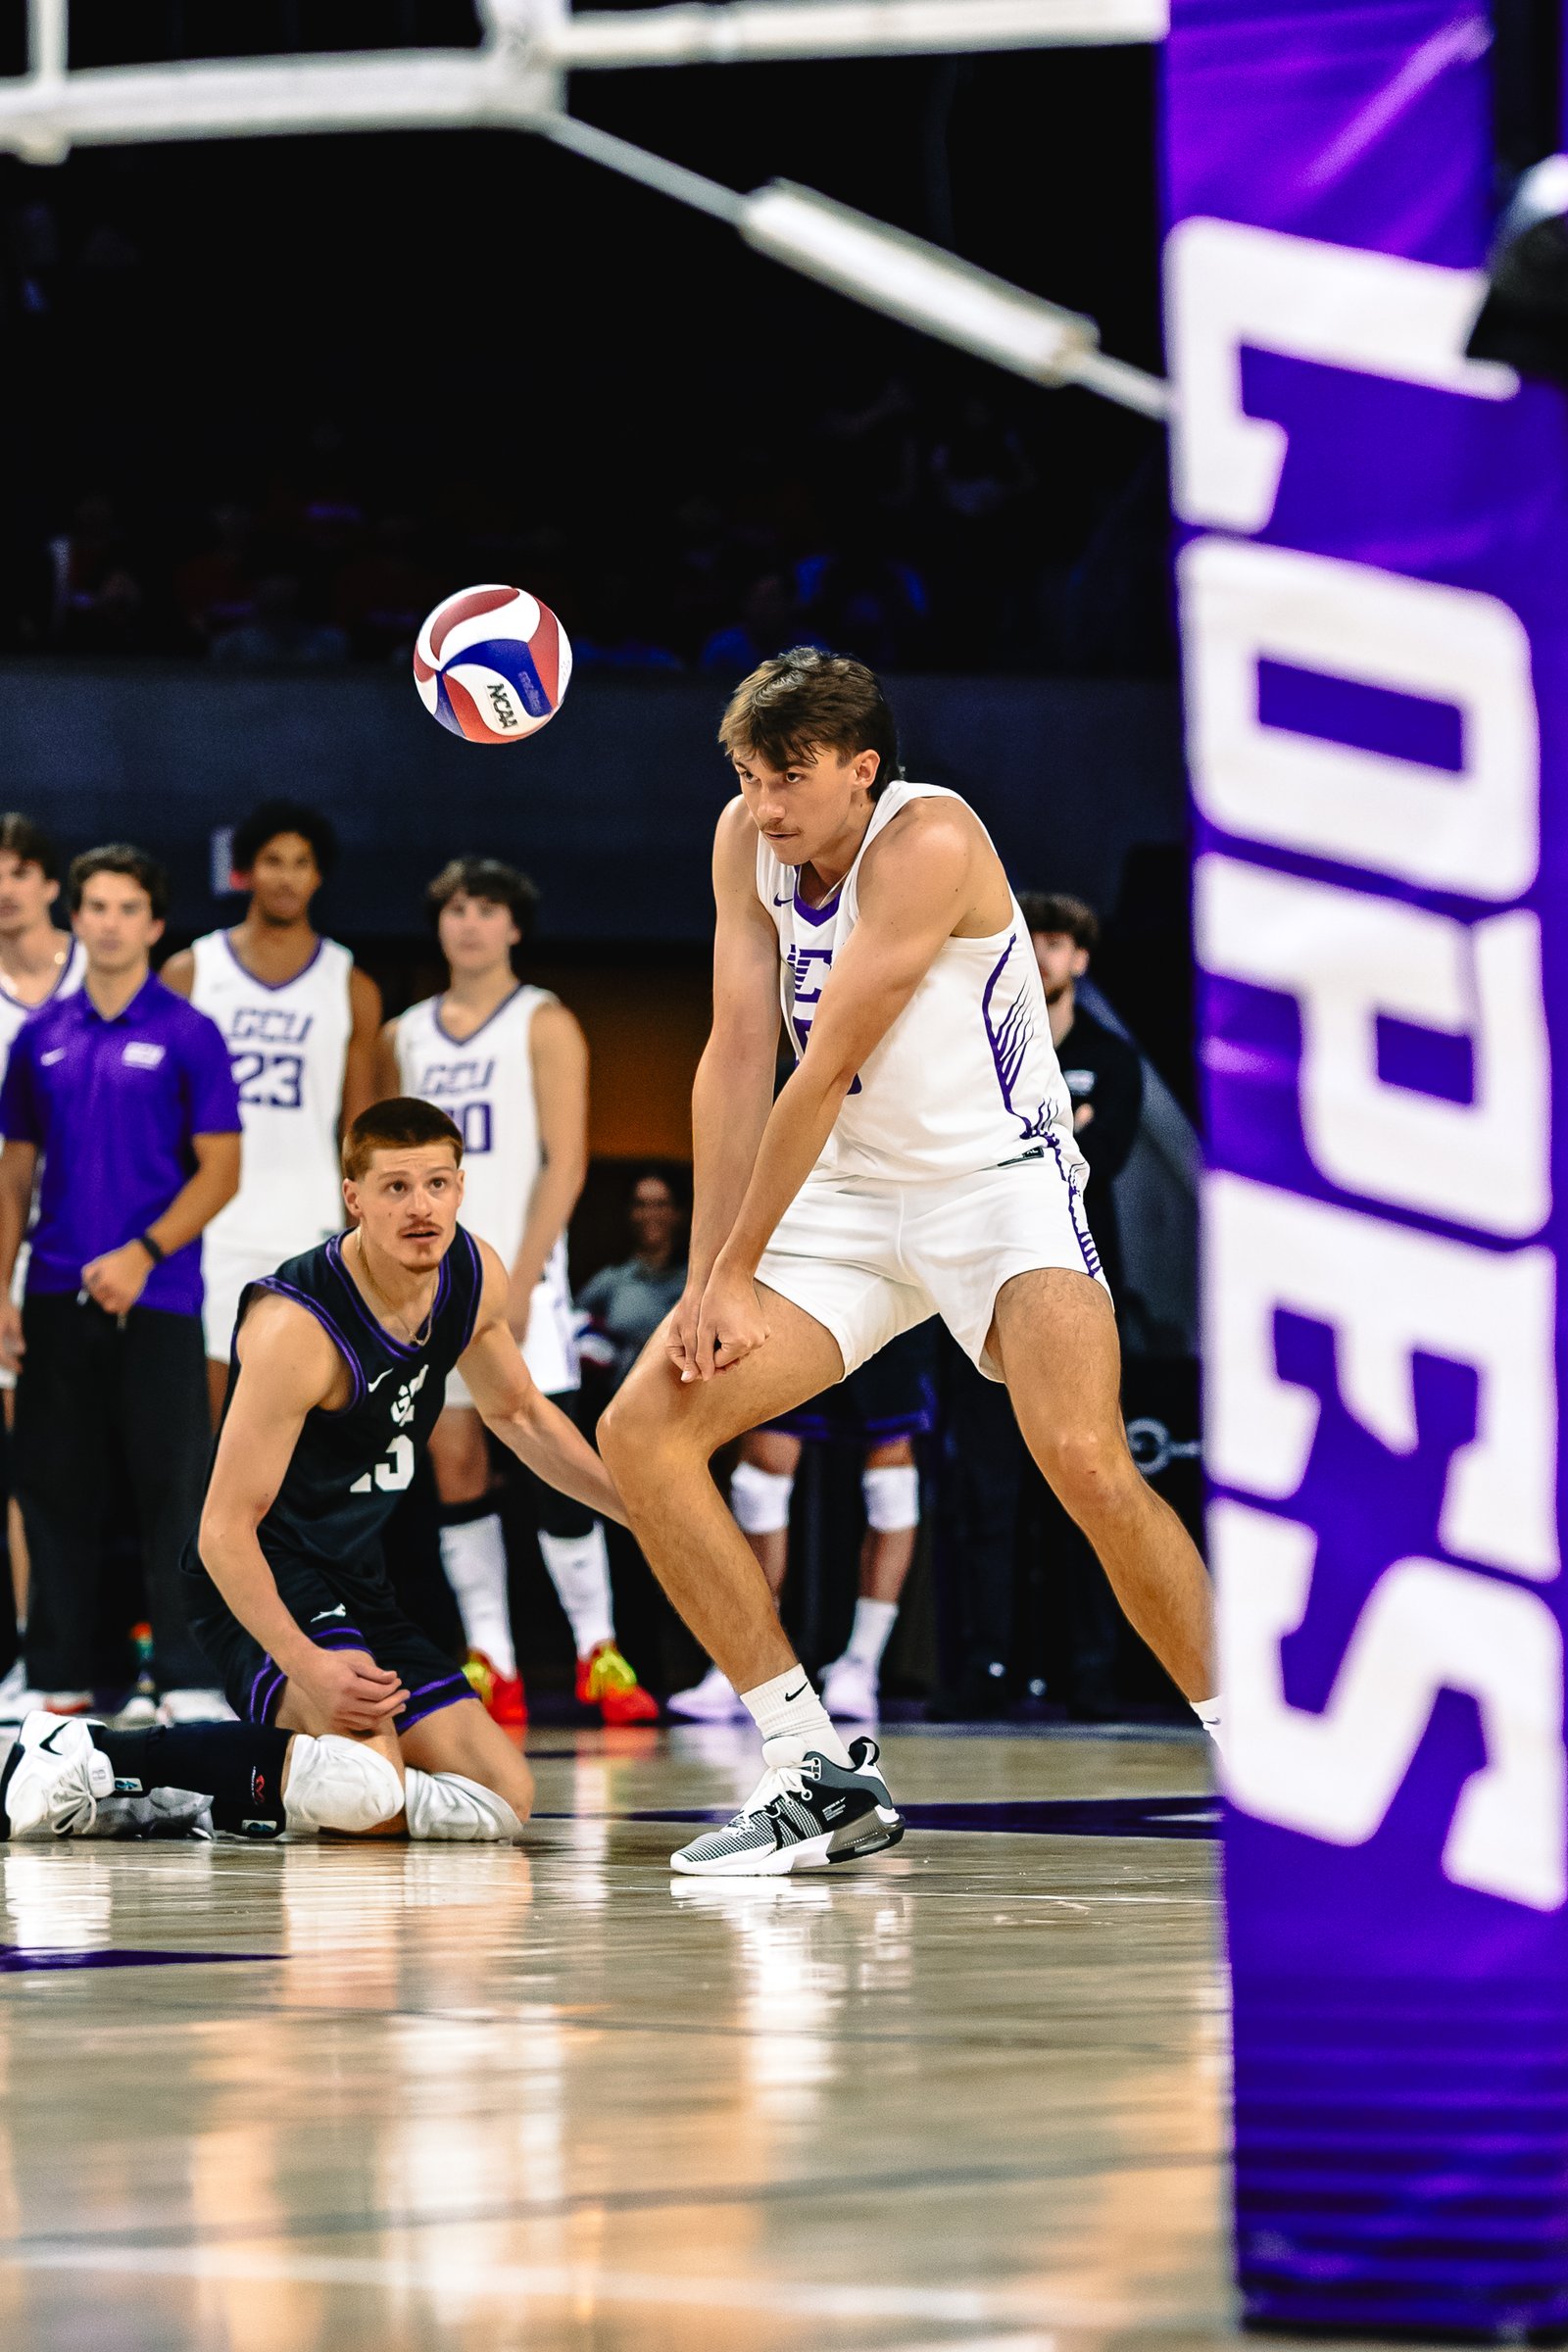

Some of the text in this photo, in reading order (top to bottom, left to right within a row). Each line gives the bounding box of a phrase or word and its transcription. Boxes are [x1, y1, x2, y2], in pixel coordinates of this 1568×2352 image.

[487, 683, 517, 728] NCAA
[228, 1006, 314, 1043] GCU
[229, 1051, 303, 1108] 23
[418, 1057, 496, 1096] GCU
[1164, 215, 1566, 1912] LOPES
[443, 1102, 493, 1153] 0
